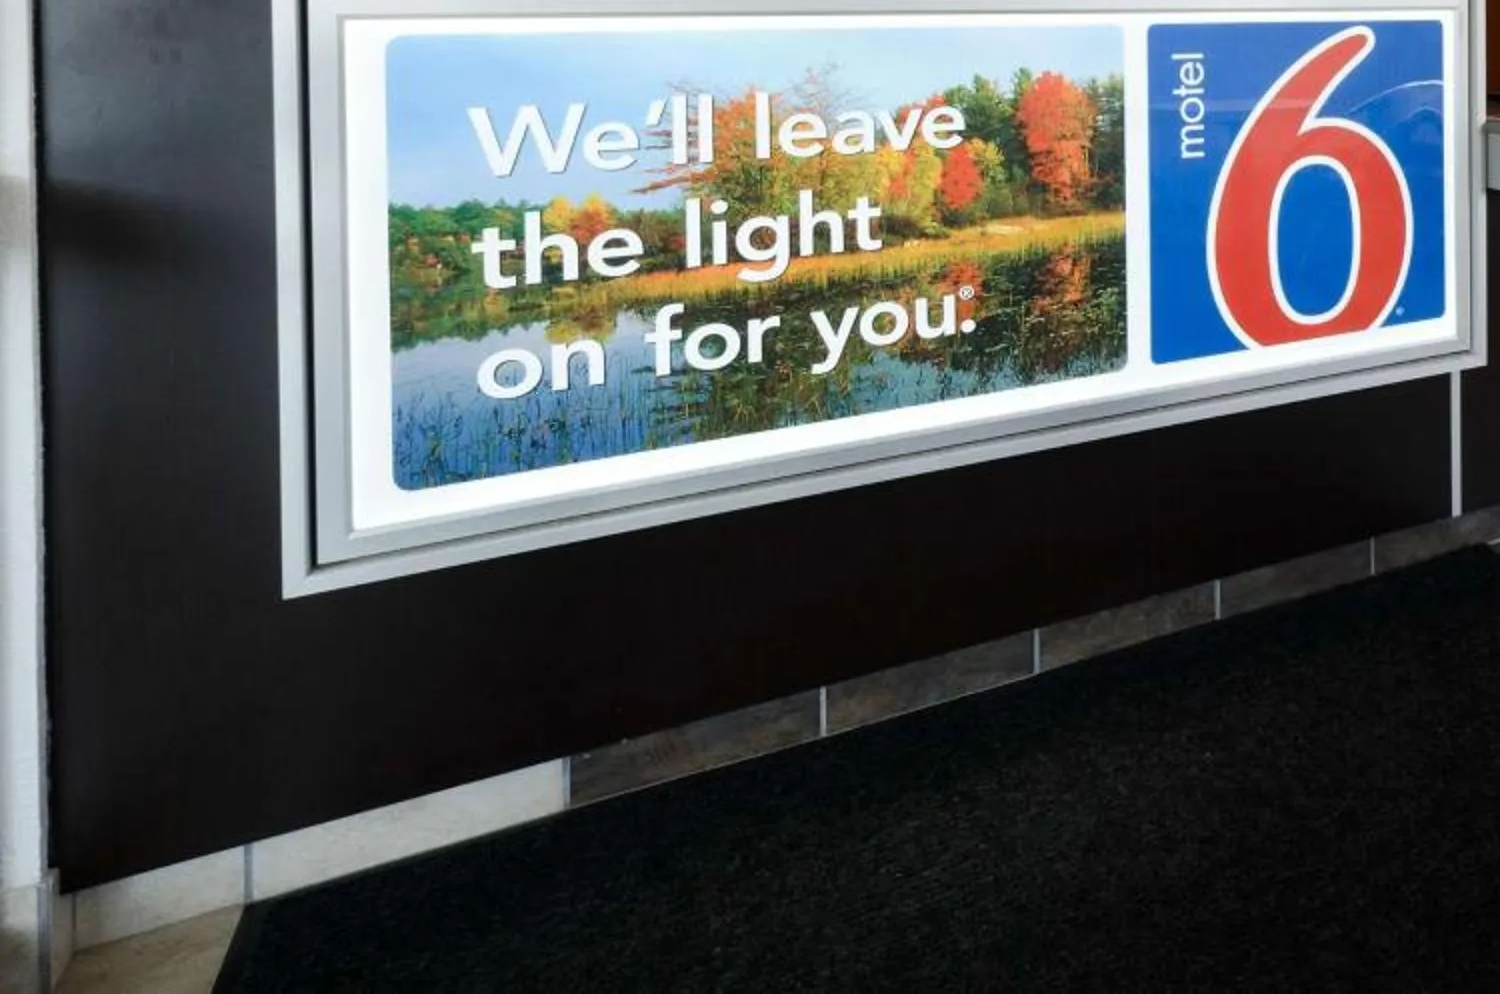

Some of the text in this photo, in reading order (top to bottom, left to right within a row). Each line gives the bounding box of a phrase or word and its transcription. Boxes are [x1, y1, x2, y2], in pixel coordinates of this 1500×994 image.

[466, 91, 967, 178] We'll leave
[1171, 25, 1415, 351] motel 6
[472, 189, 883, 291] the light
[477, 338, 606, 400] on
[645, 303, 782, 377] for
